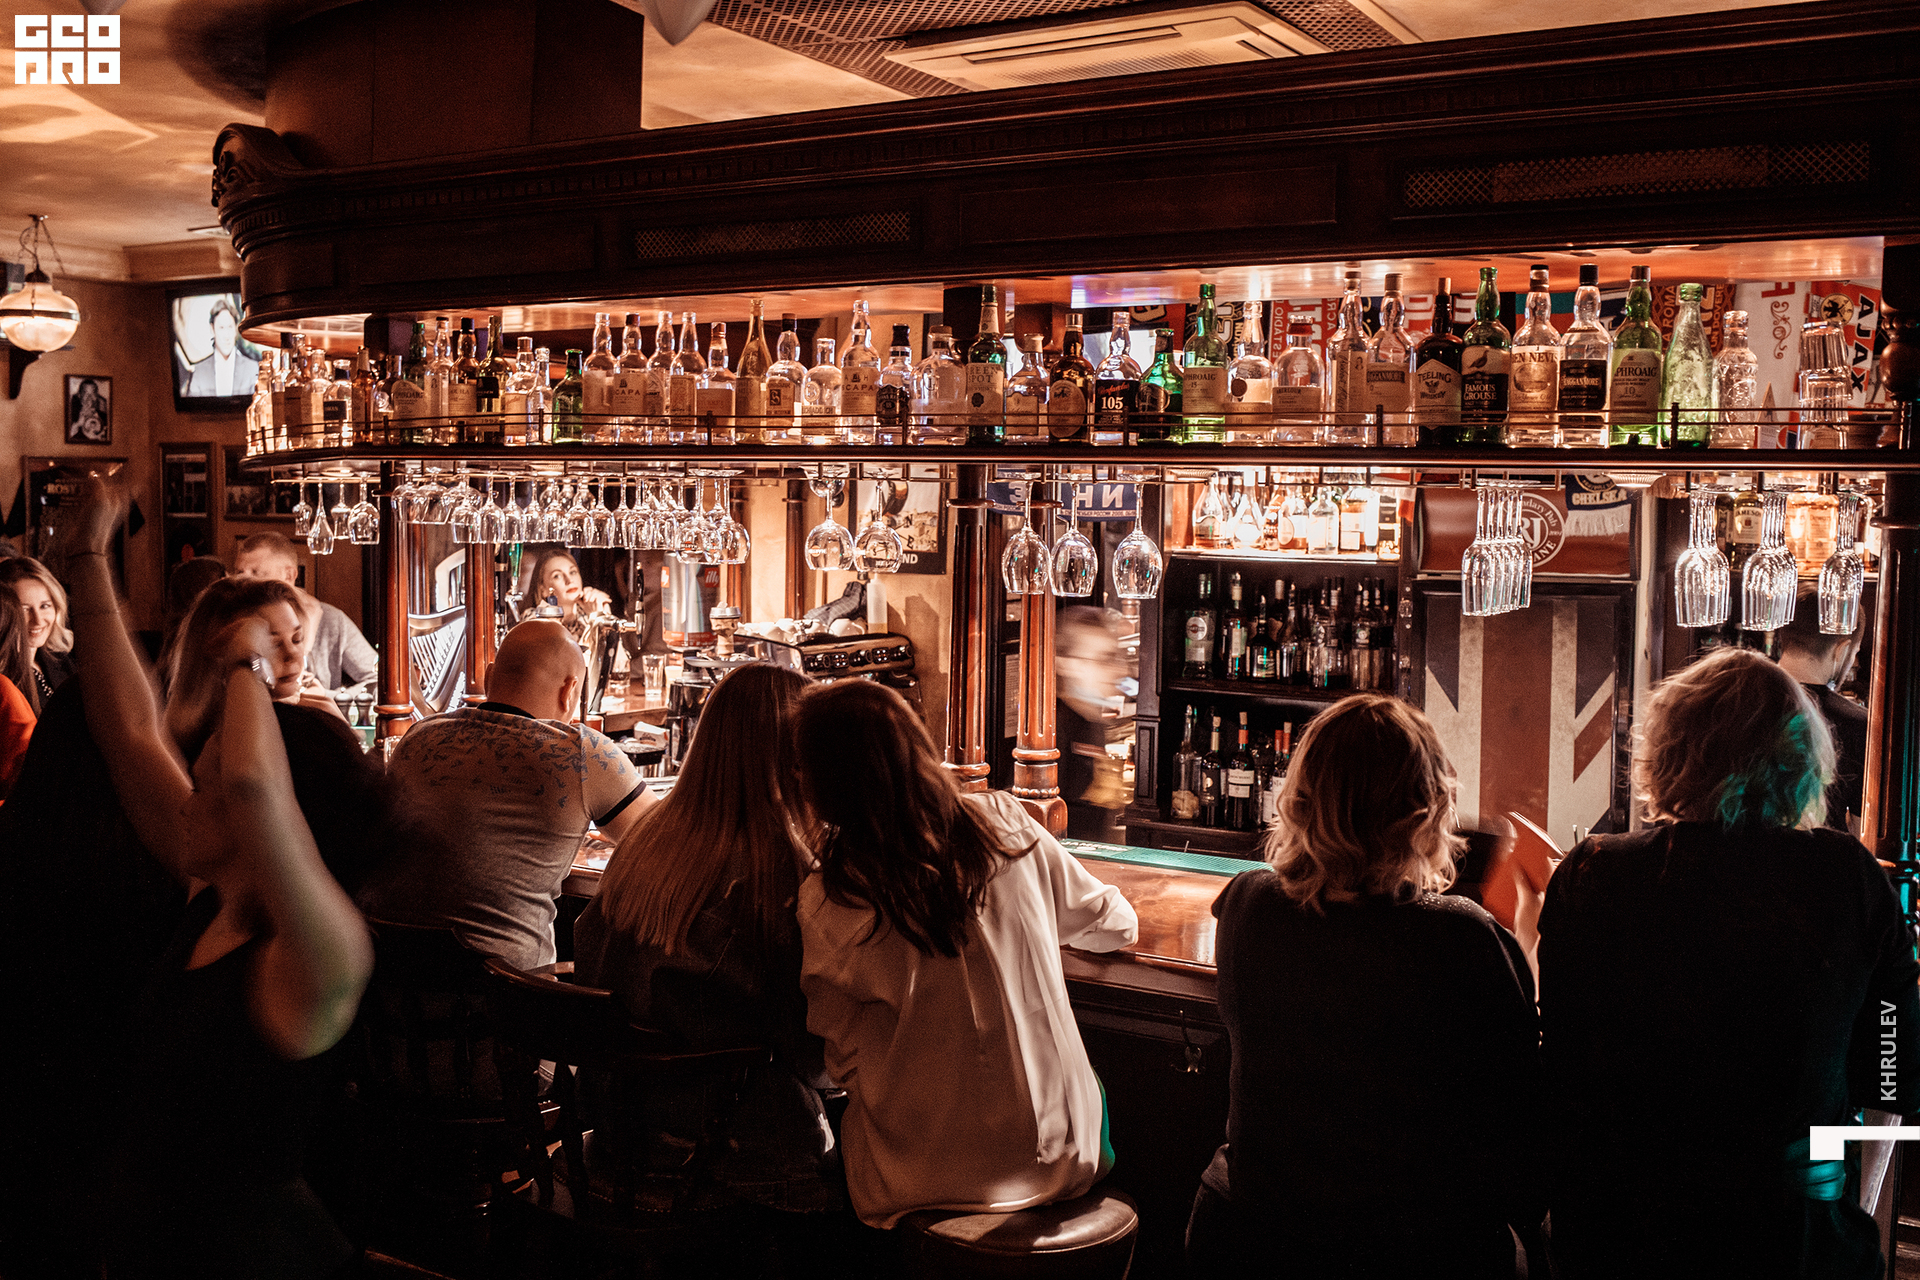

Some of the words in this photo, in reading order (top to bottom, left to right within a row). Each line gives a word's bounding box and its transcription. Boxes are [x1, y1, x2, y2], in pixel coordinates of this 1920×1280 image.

[1662, 286, 1676, 329] ROMA
[1851, 293, 1877, 394] AJAX
[1184, 372, 1218, 381] PHROAIG
[1417, 371, 1452, 384] TEELING
[1614, 366, 1658, 378] PHROAIG
[613, 388, 641, 396] CAPA
[1464, 383, 1496, 392] FAMOUS
[1624, 386, 1636, 395] 10
[1463, 391, 1498, 401] GROUSE
[1102, 396, 1124, 410] 105
[1571, 488, 1628, 506] CHELSEA
[1544, 509, 1558, 527] Pub
[1533, 540, 1557, 562] ANE
[704, 569, 719, 588] illy
